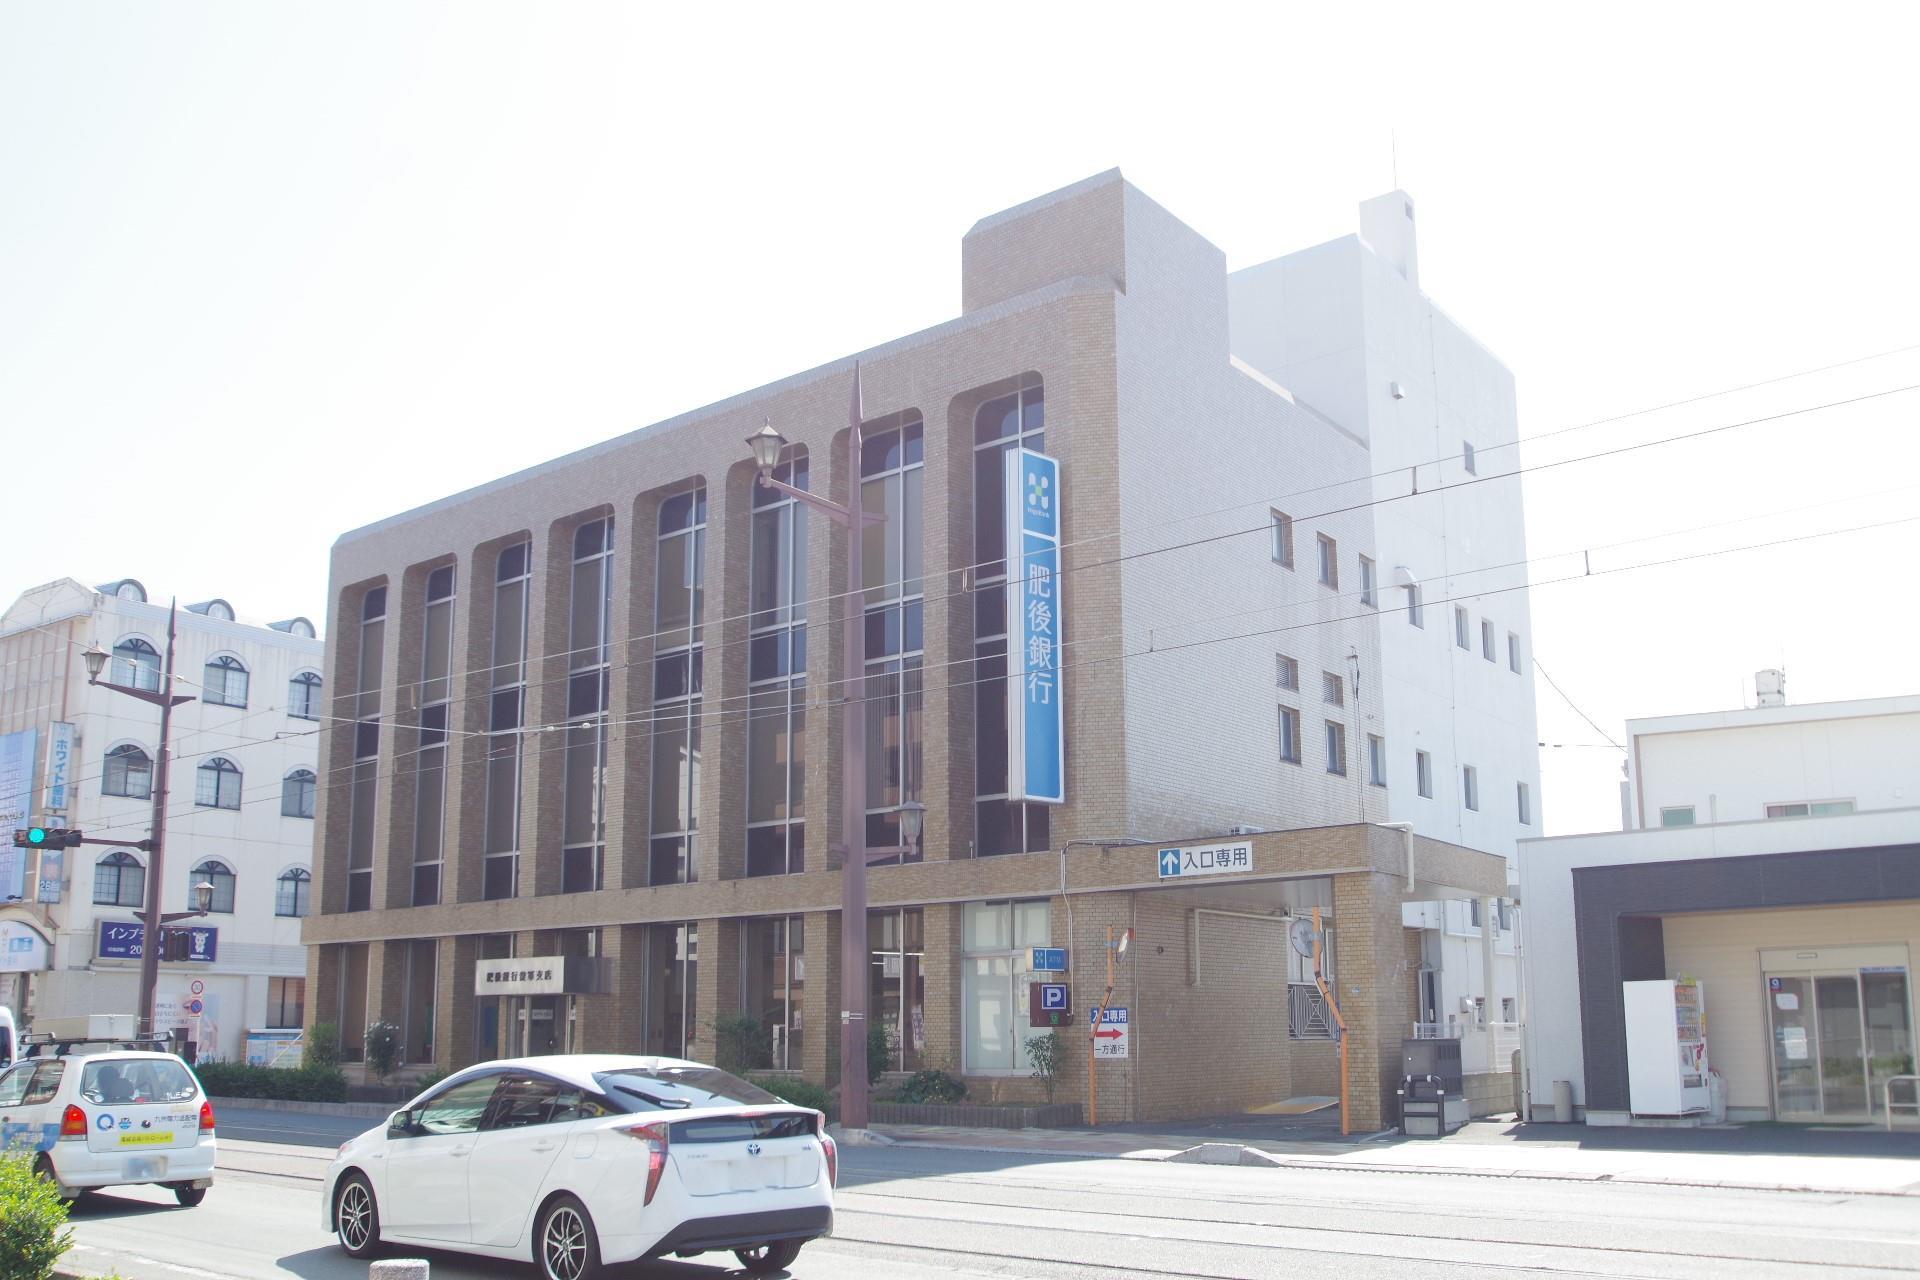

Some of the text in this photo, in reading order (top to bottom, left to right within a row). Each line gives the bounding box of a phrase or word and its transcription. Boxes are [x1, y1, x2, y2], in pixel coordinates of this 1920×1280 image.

[1028, 564, 1053, 705] 肥後銀行
[1183, 847, 1248, 871] 入口専用
[1046, 988, 1062, 1007] P
[1095, 1044, 1125, 1055] 一方通行
